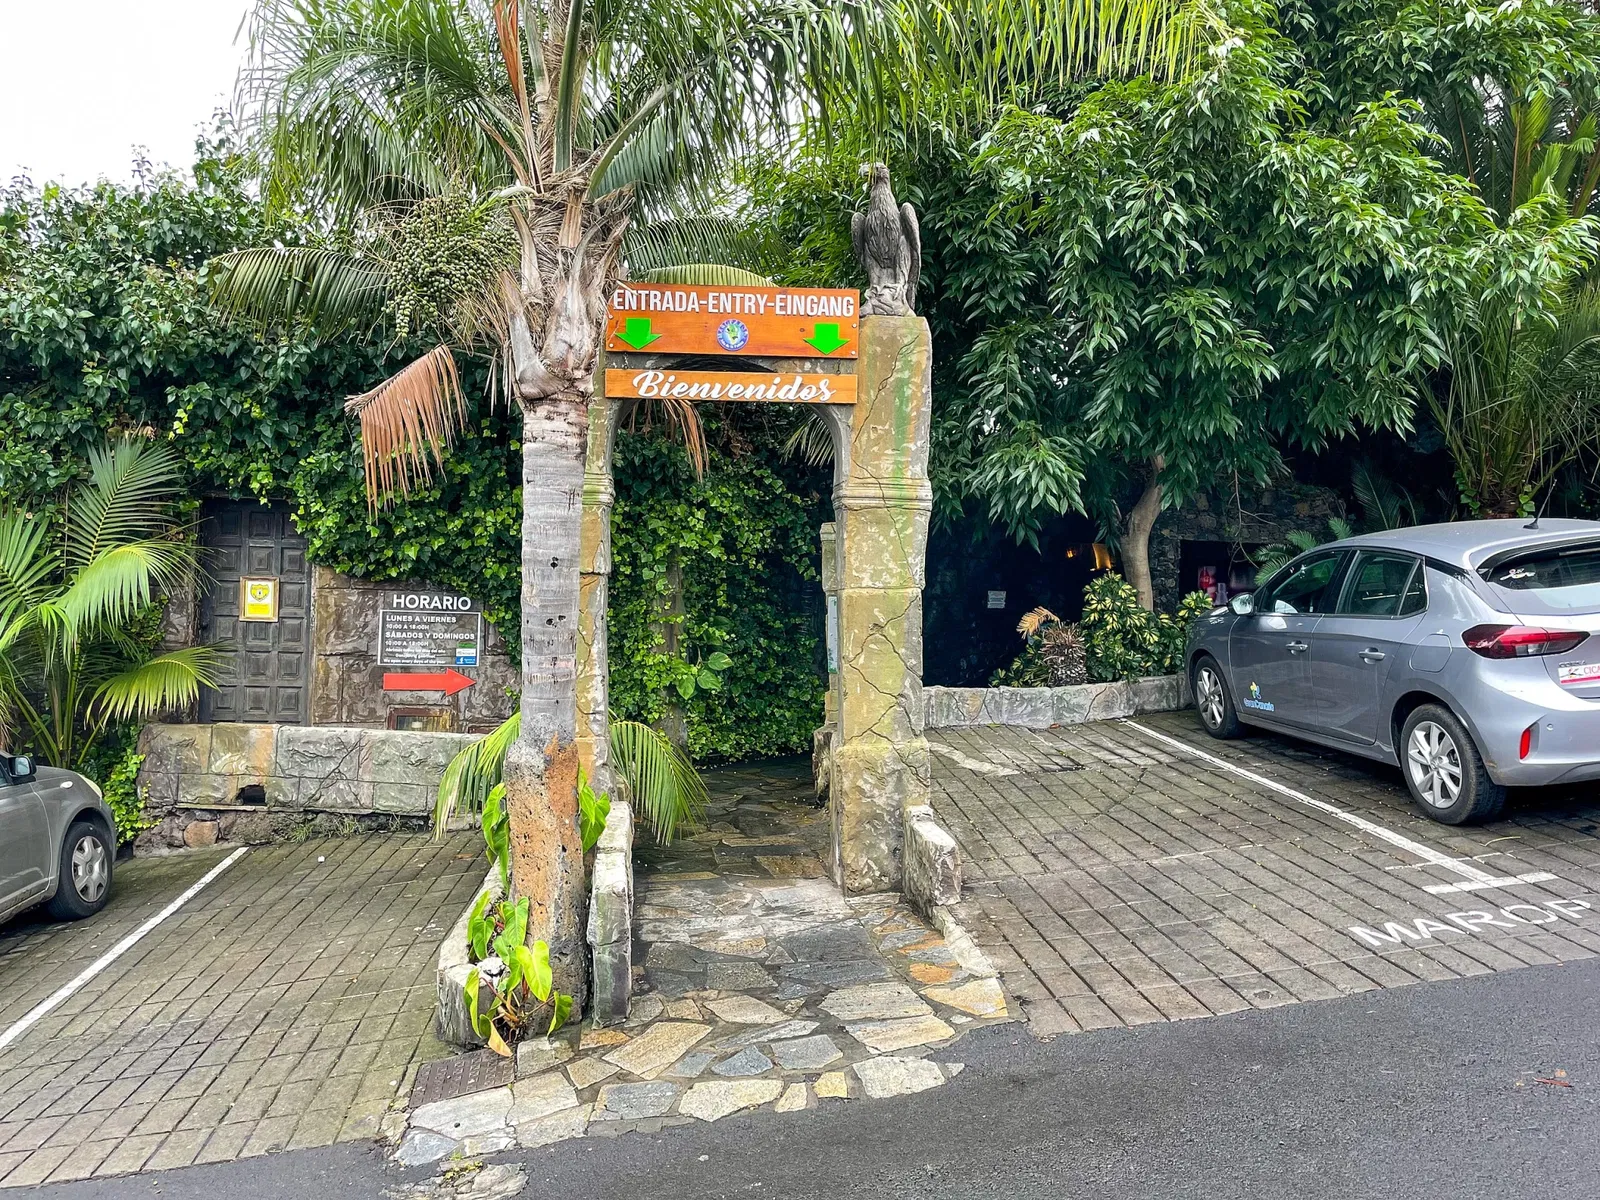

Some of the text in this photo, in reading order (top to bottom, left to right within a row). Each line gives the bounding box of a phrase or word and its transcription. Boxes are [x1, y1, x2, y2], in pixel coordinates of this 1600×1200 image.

[613, 289, 855, 317] ENTRADA-ENTRY-EINGANG
[632, 370, 836, 401] Bienvenidos
[393, 594, 471, 610] HORARIO
[385, 630, 423, 638] SÁBADOS
[1348, 899, 1592, 947] MAROP
